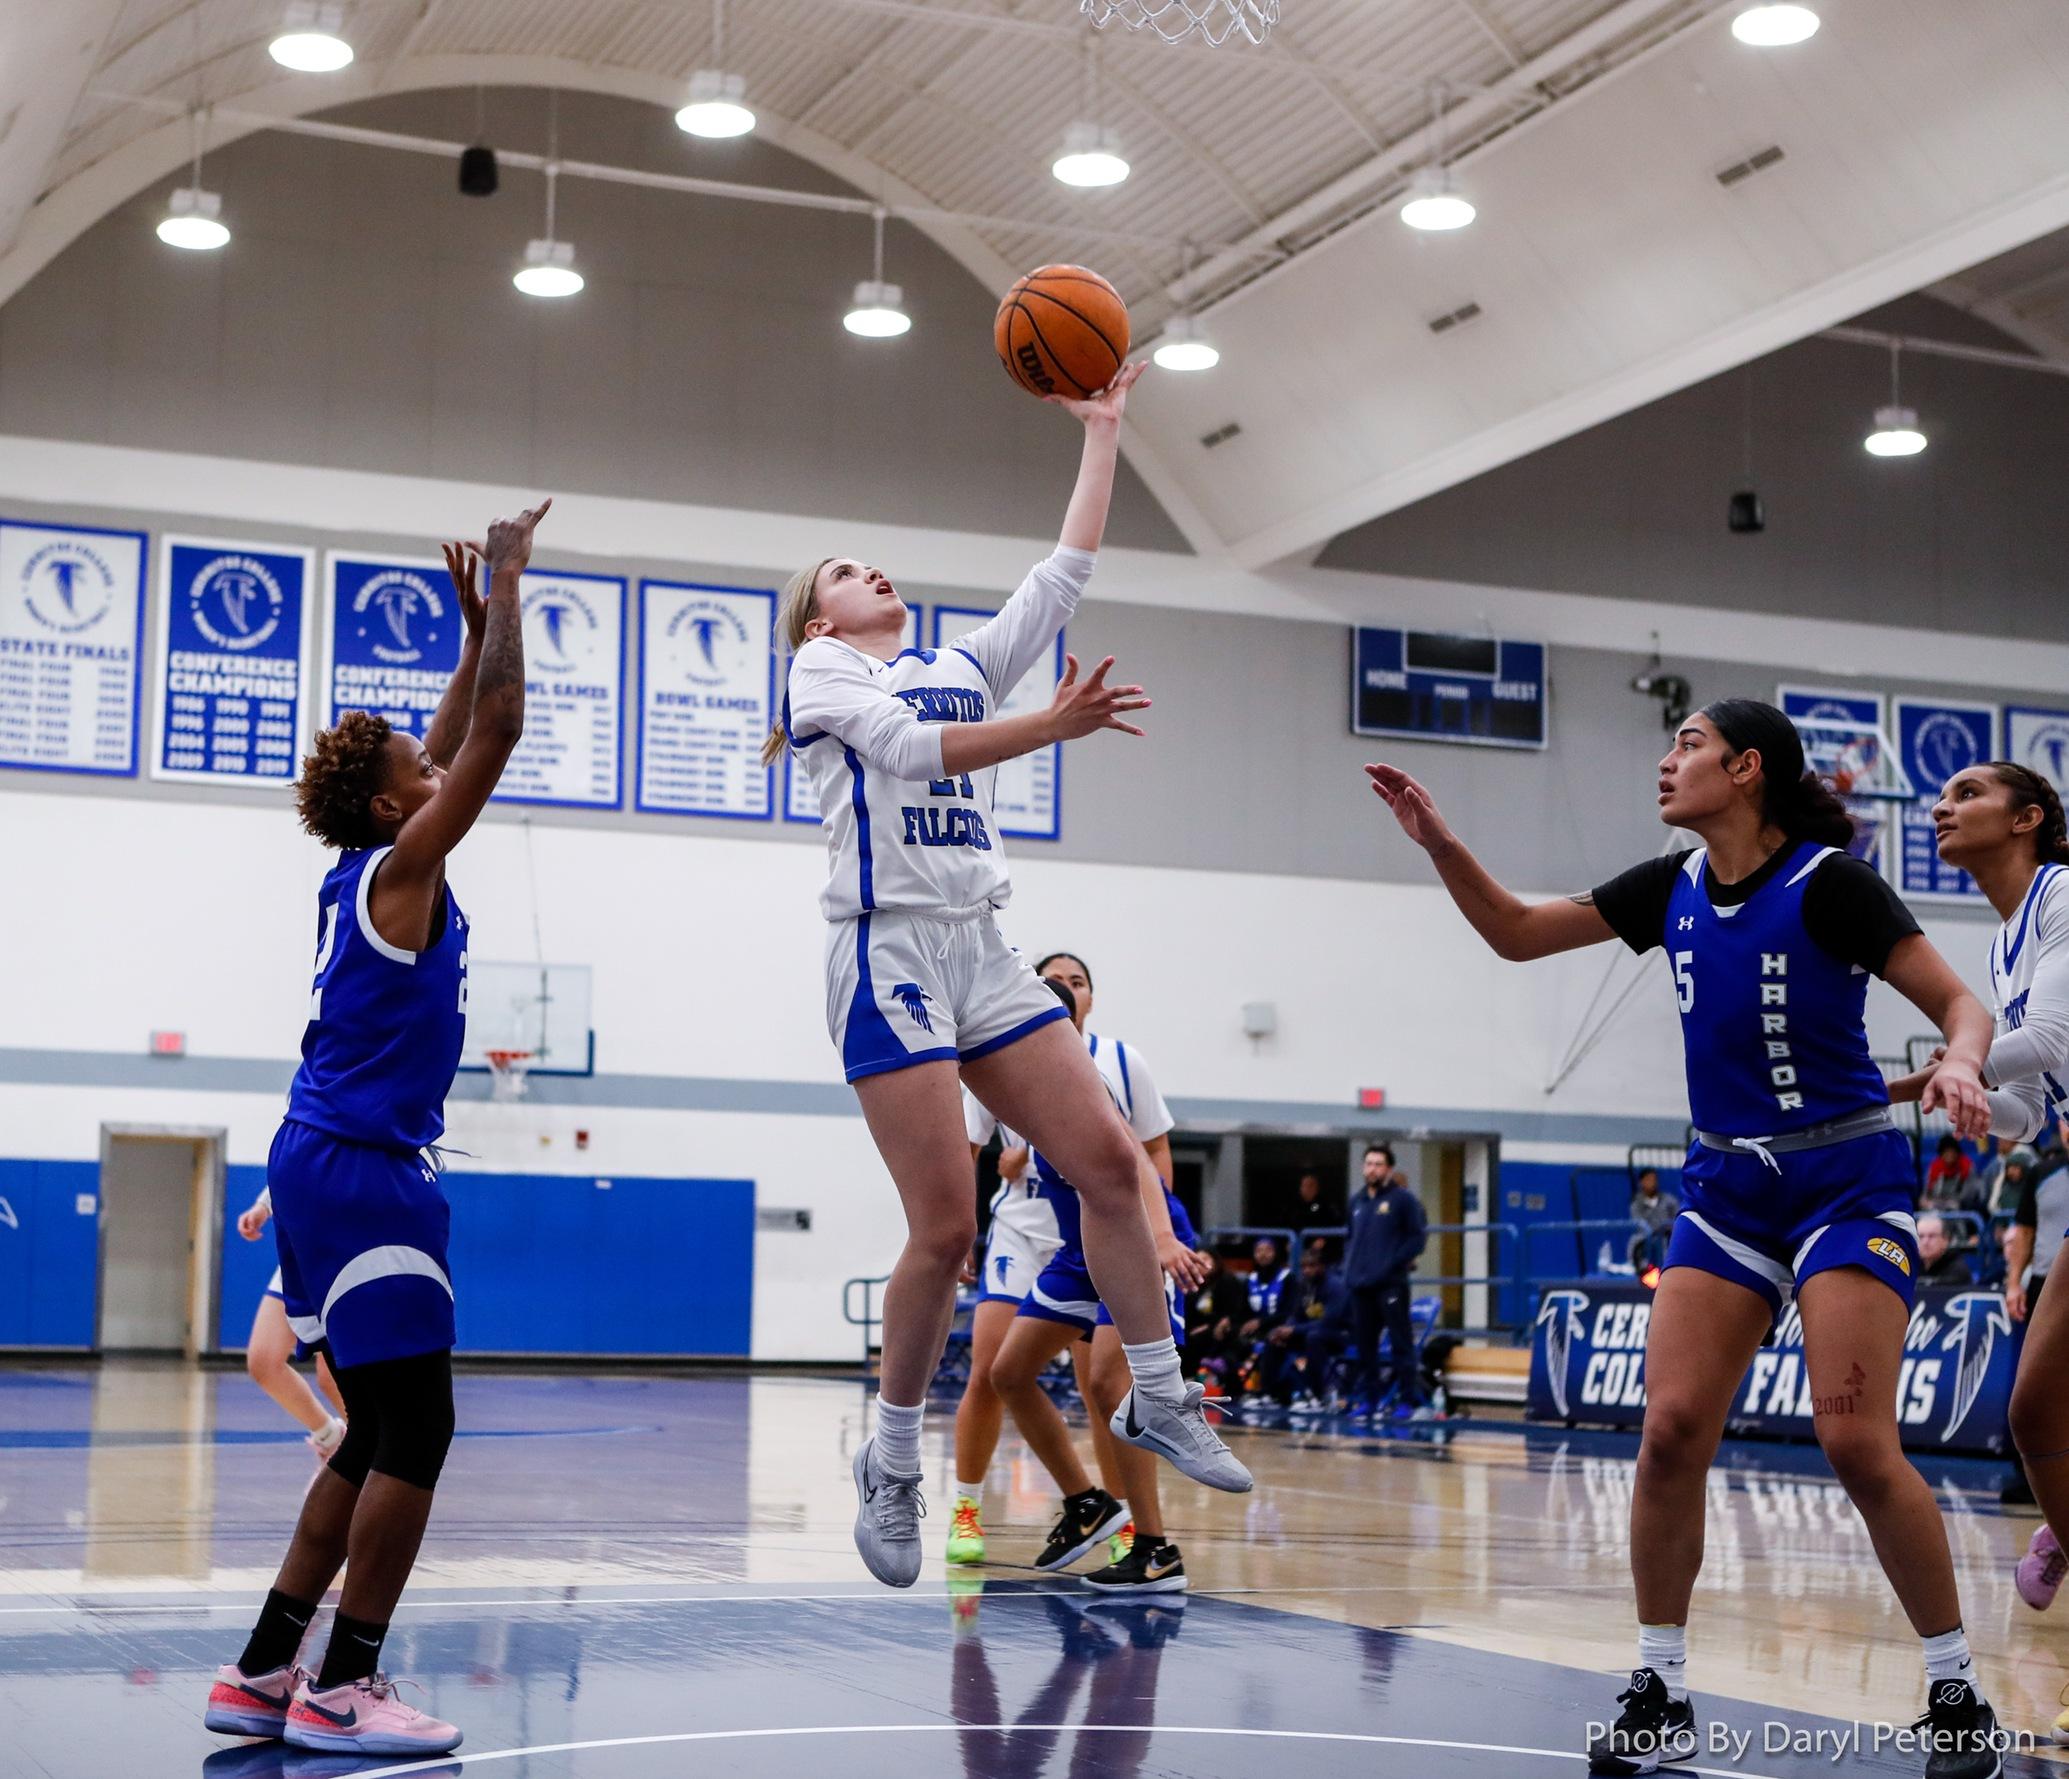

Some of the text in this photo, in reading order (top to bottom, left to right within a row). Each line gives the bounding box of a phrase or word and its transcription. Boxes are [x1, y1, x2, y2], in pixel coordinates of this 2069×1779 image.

[0, 638, 130, 661] STATE FINALS
[169, 650, 298, 679] CONFERENCE
[168, 671, 298, 700] CHAMPIONS
[335, 664, 454, 690] CONFERENC
[334, 683, 447, 711] CHAMPION
[524, 682, 610, 700] WL GAMES
[655, 692, 760, 713] BOWL GAMES
[1492, 682, 1537, 700] GUEST
[892, 686, 985, 723] ERRITOS
[1760, 952, 1804, 1112] HARBOR
[1878, 1241, 1906, 1264] LA
[1816, 1395, 1855, 1416] 2001
